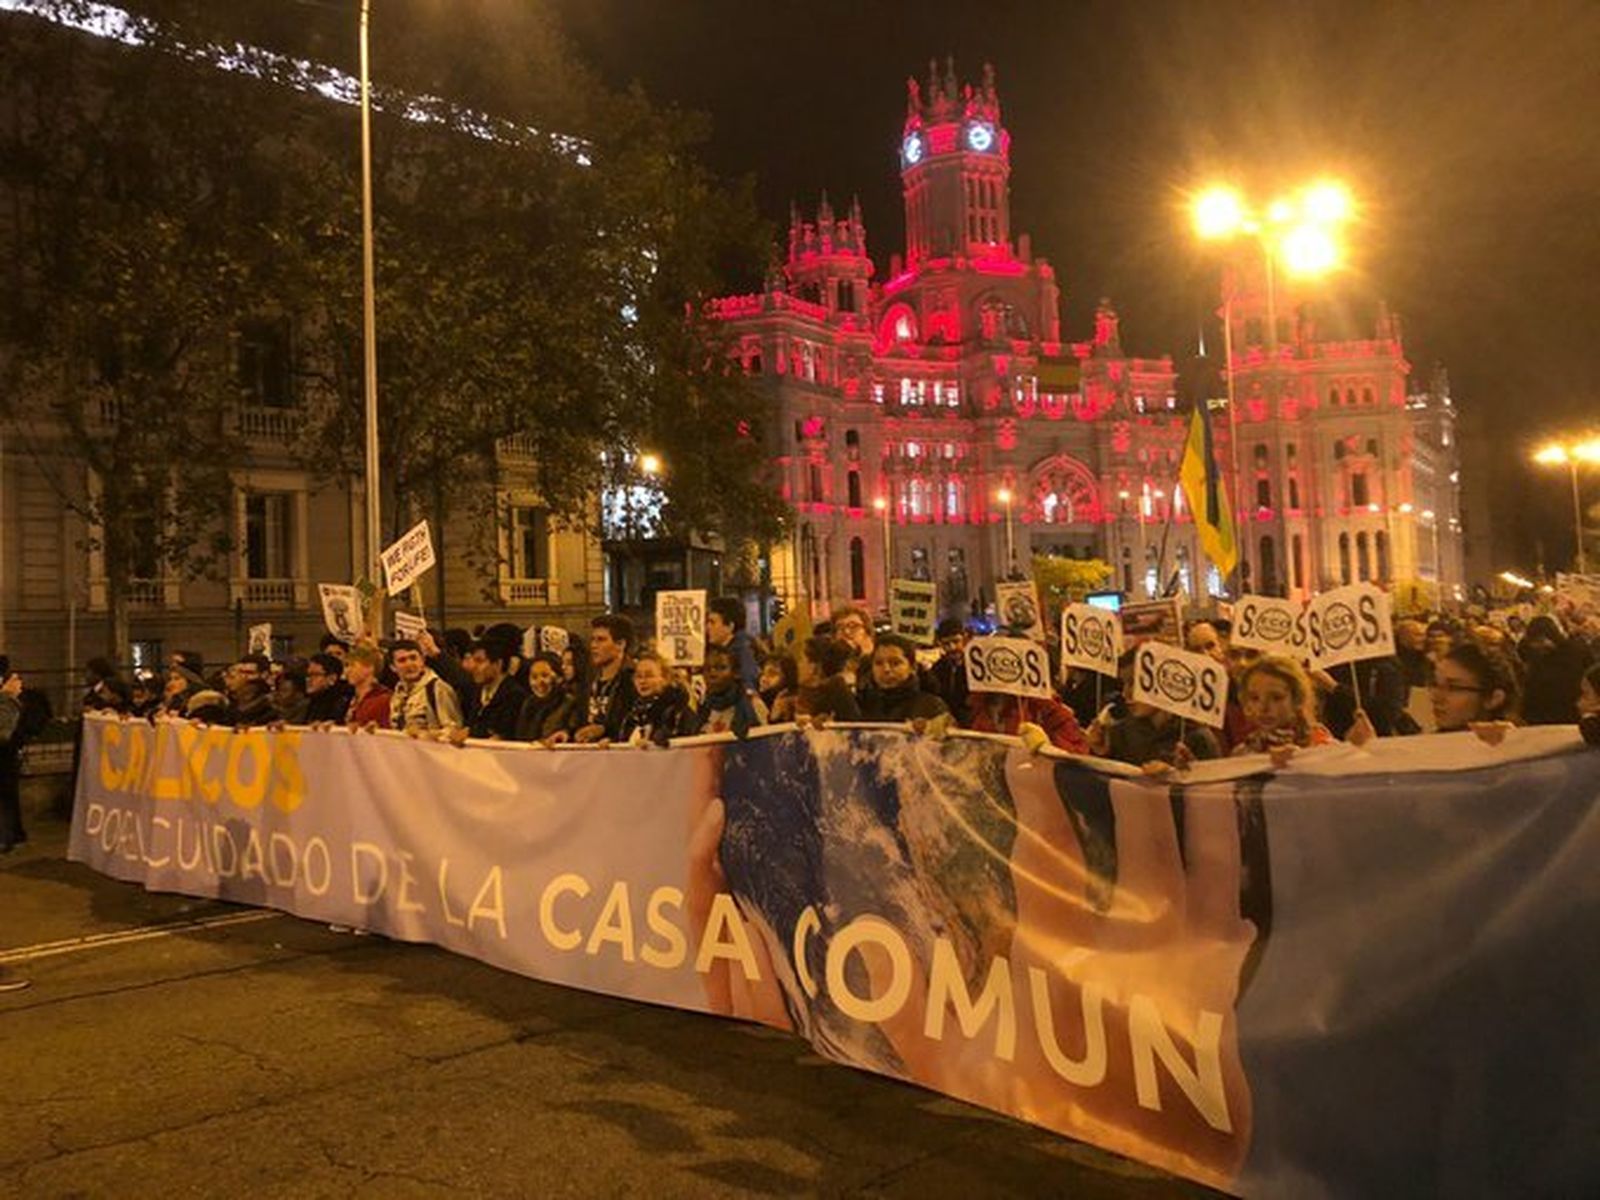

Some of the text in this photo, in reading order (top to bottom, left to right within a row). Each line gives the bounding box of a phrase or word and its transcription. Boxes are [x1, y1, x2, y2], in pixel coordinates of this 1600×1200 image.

[351, 842, 425, 913] DE
[438, 857, 507, 940] LA
[540, 872, 762, 982] CASA
